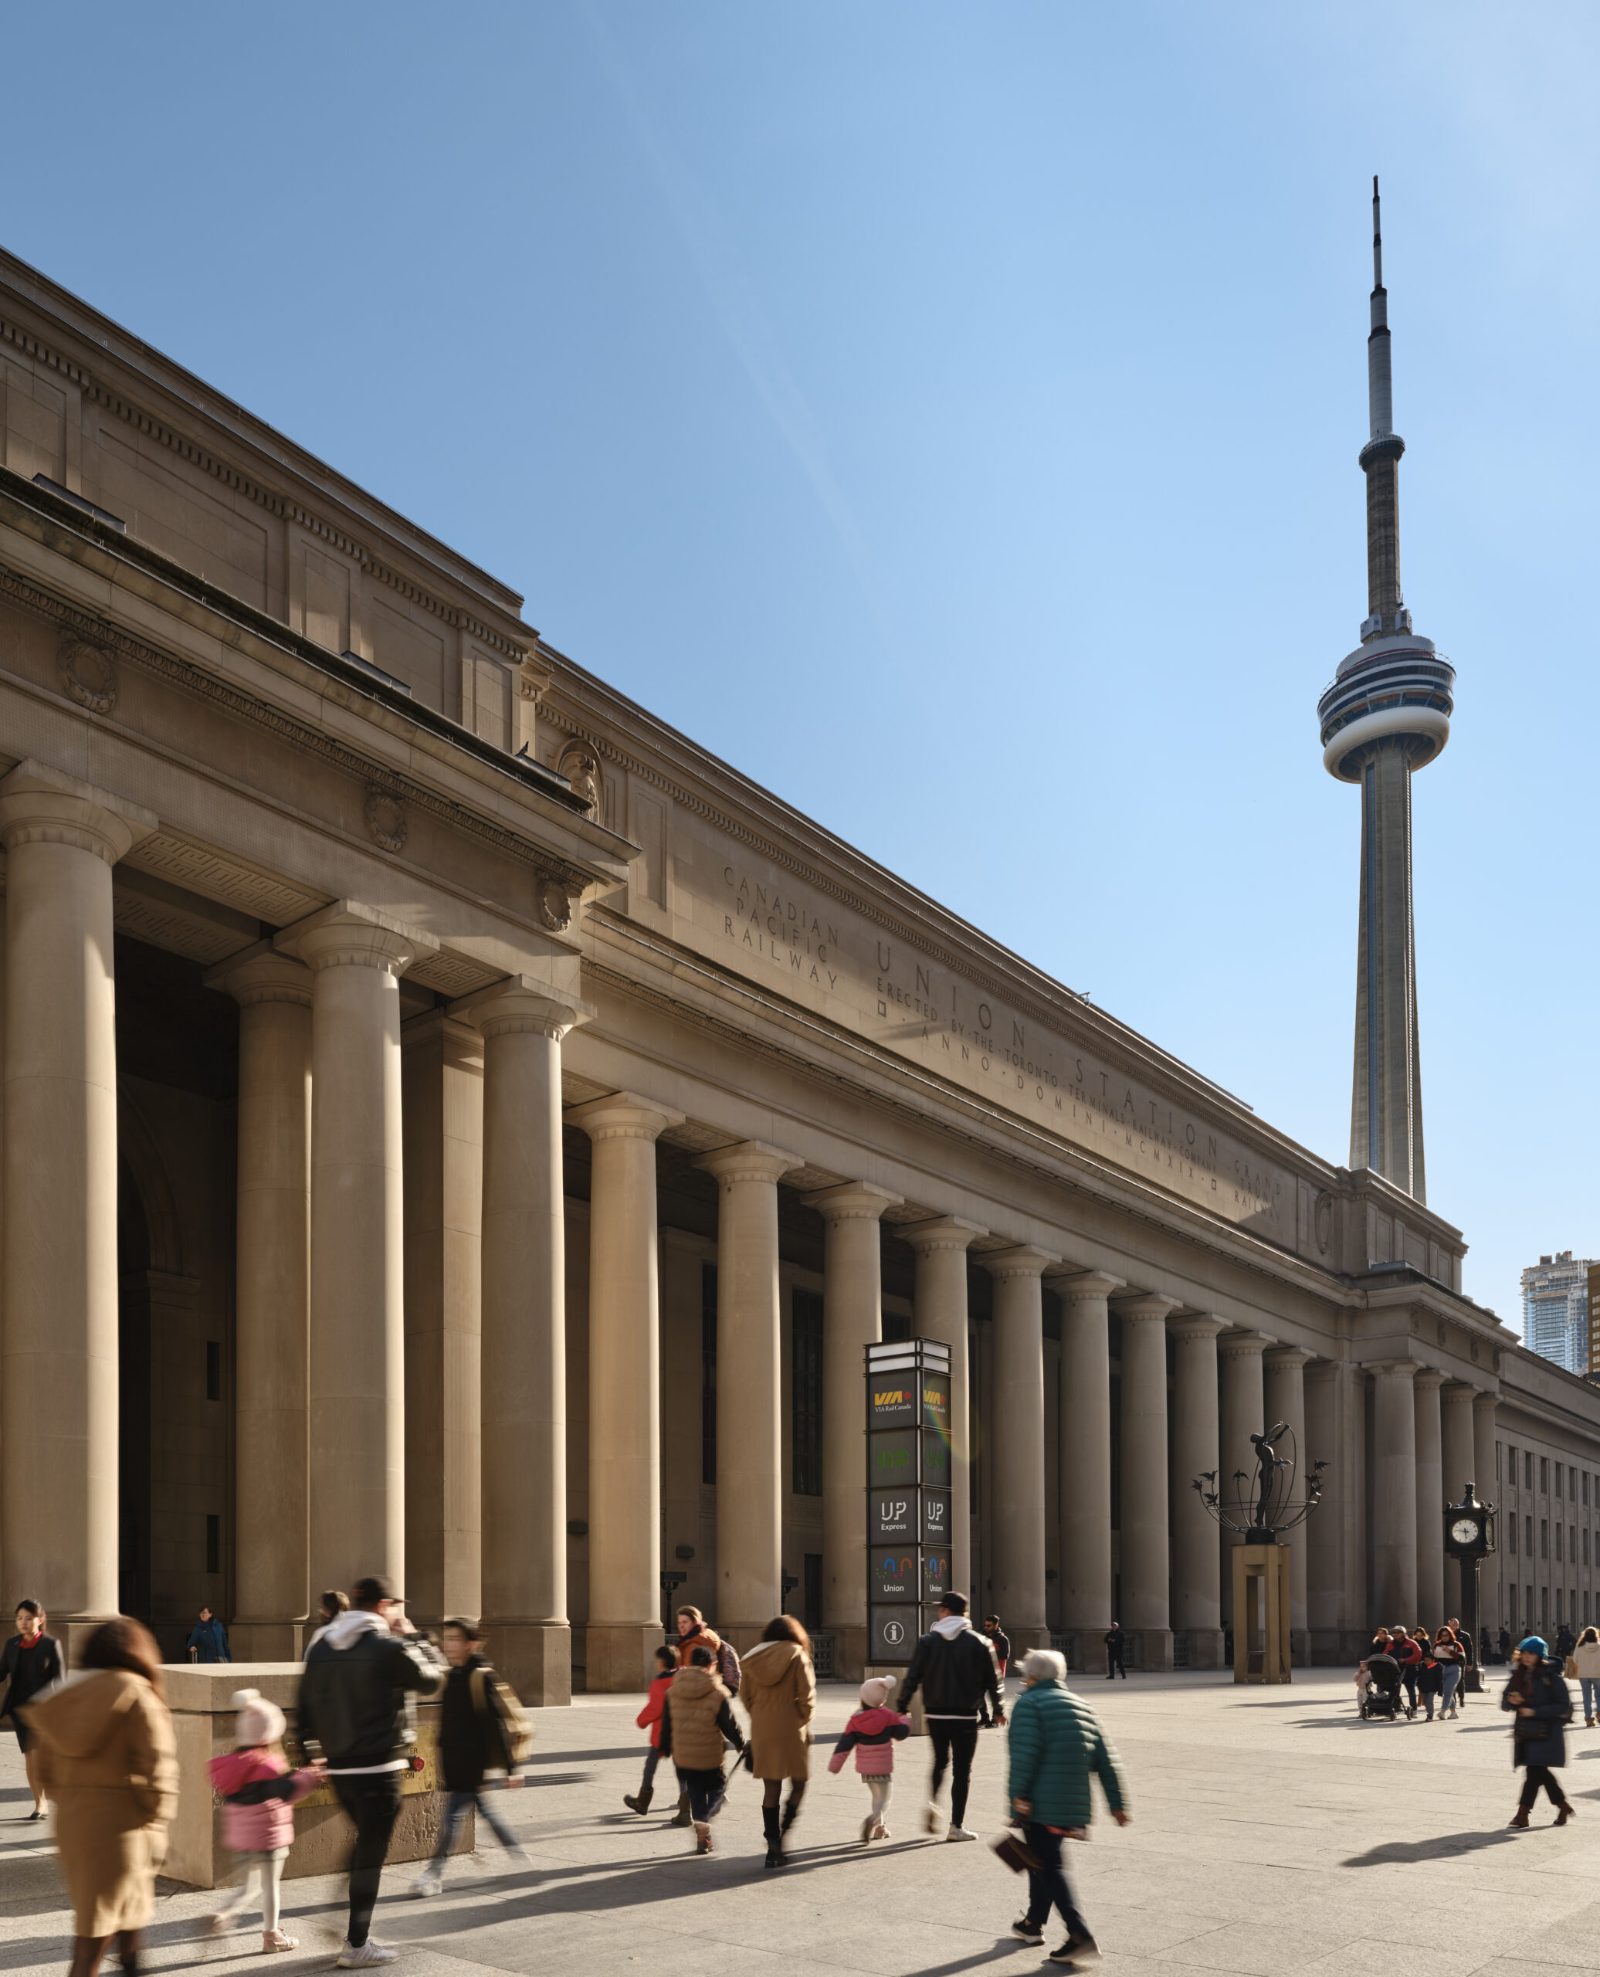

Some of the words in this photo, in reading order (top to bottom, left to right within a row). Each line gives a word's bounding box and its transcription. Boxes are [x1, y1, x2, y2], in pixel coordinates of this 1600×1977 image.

[723, 866, 839, 945] CANADIAN
[736, 897, 828, 963] PACIFIC
[724, 915, 838, 990] RAILWAY
[877, 977, 938, 1022] ERECTED
[951, 1020, 966, 1036] BY
[973, 1031, 994, 1053] THE
[1004, 1048, 1058, 1088] TORONTO
[876, 940, 1026, 1051] UNION
[1073, 1058, 1218, 1157] STATION
[921, 1025, 991, 1072] ANNO
[1017, 1074, 1106, 1134] DOMINI
[874, 1391, 903, 1406] VIA
[895, 1403, 912, 1411] Canada
[923, 1389, 941, 1405] VIA
[881, 1501, 907, 1521] UP
[927, 1501, 944, 1521] UP
[881, 1523, 907, 1531] Express
[927, 1522, 944, 1531] Express
[883, 1584, 905, 1592] Union
[929, 1584, 943, 1592] Union
